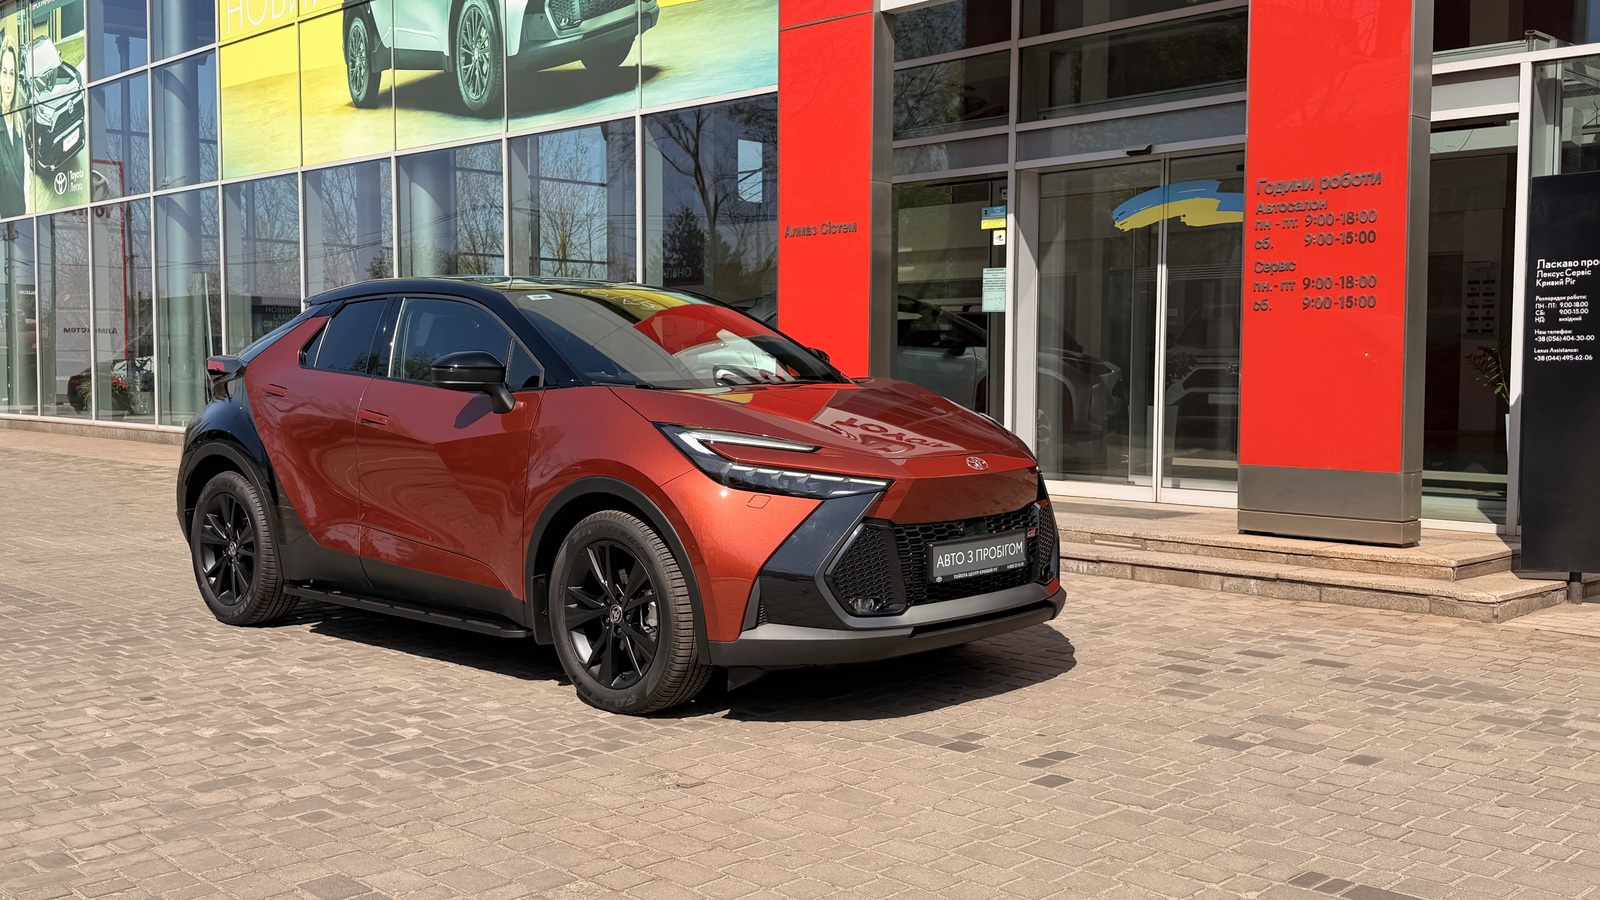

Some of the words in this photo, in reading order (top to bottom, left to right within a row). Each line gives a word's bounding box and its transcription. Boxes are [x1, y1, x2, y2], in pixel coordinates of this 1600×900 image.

[1256, 179, 1315, 196] Години
[1319, 171, 1382, 194] роботи
[1255, 199, 1328, 215] Автосалон
[1304, 209, 1378, 227] 9:00-18:00
[784, 225, 818, 238] Алмаз
[820, 221, 857, 235] Сістем
[1254, 236, 1274, 250] сб.
[1303, 229, 1377, 247] 9:00-15:00
[1253, 259, 1297, 276] Сервіс
[1536, 258, 1579, 269] Ласкаво
[1580, 258, 1600, 268] про
[1536, 270, 1564, 278] Лексус
[1565, 268, 1592, 277] Сервіс
[1302, 274, 1378, 290] 9:00-18:00
[1535, 278, 1564, 288] Кривий
[1565, 277, 1576, 285] Ріг
[1252, 298, 1272, 311] сб.
[1301, 294, 1377, 310] 9:00-15:00
[936, 551, 965, 568] АВТО
[975, 541, 1023, 562] ПРОБІГОМ
